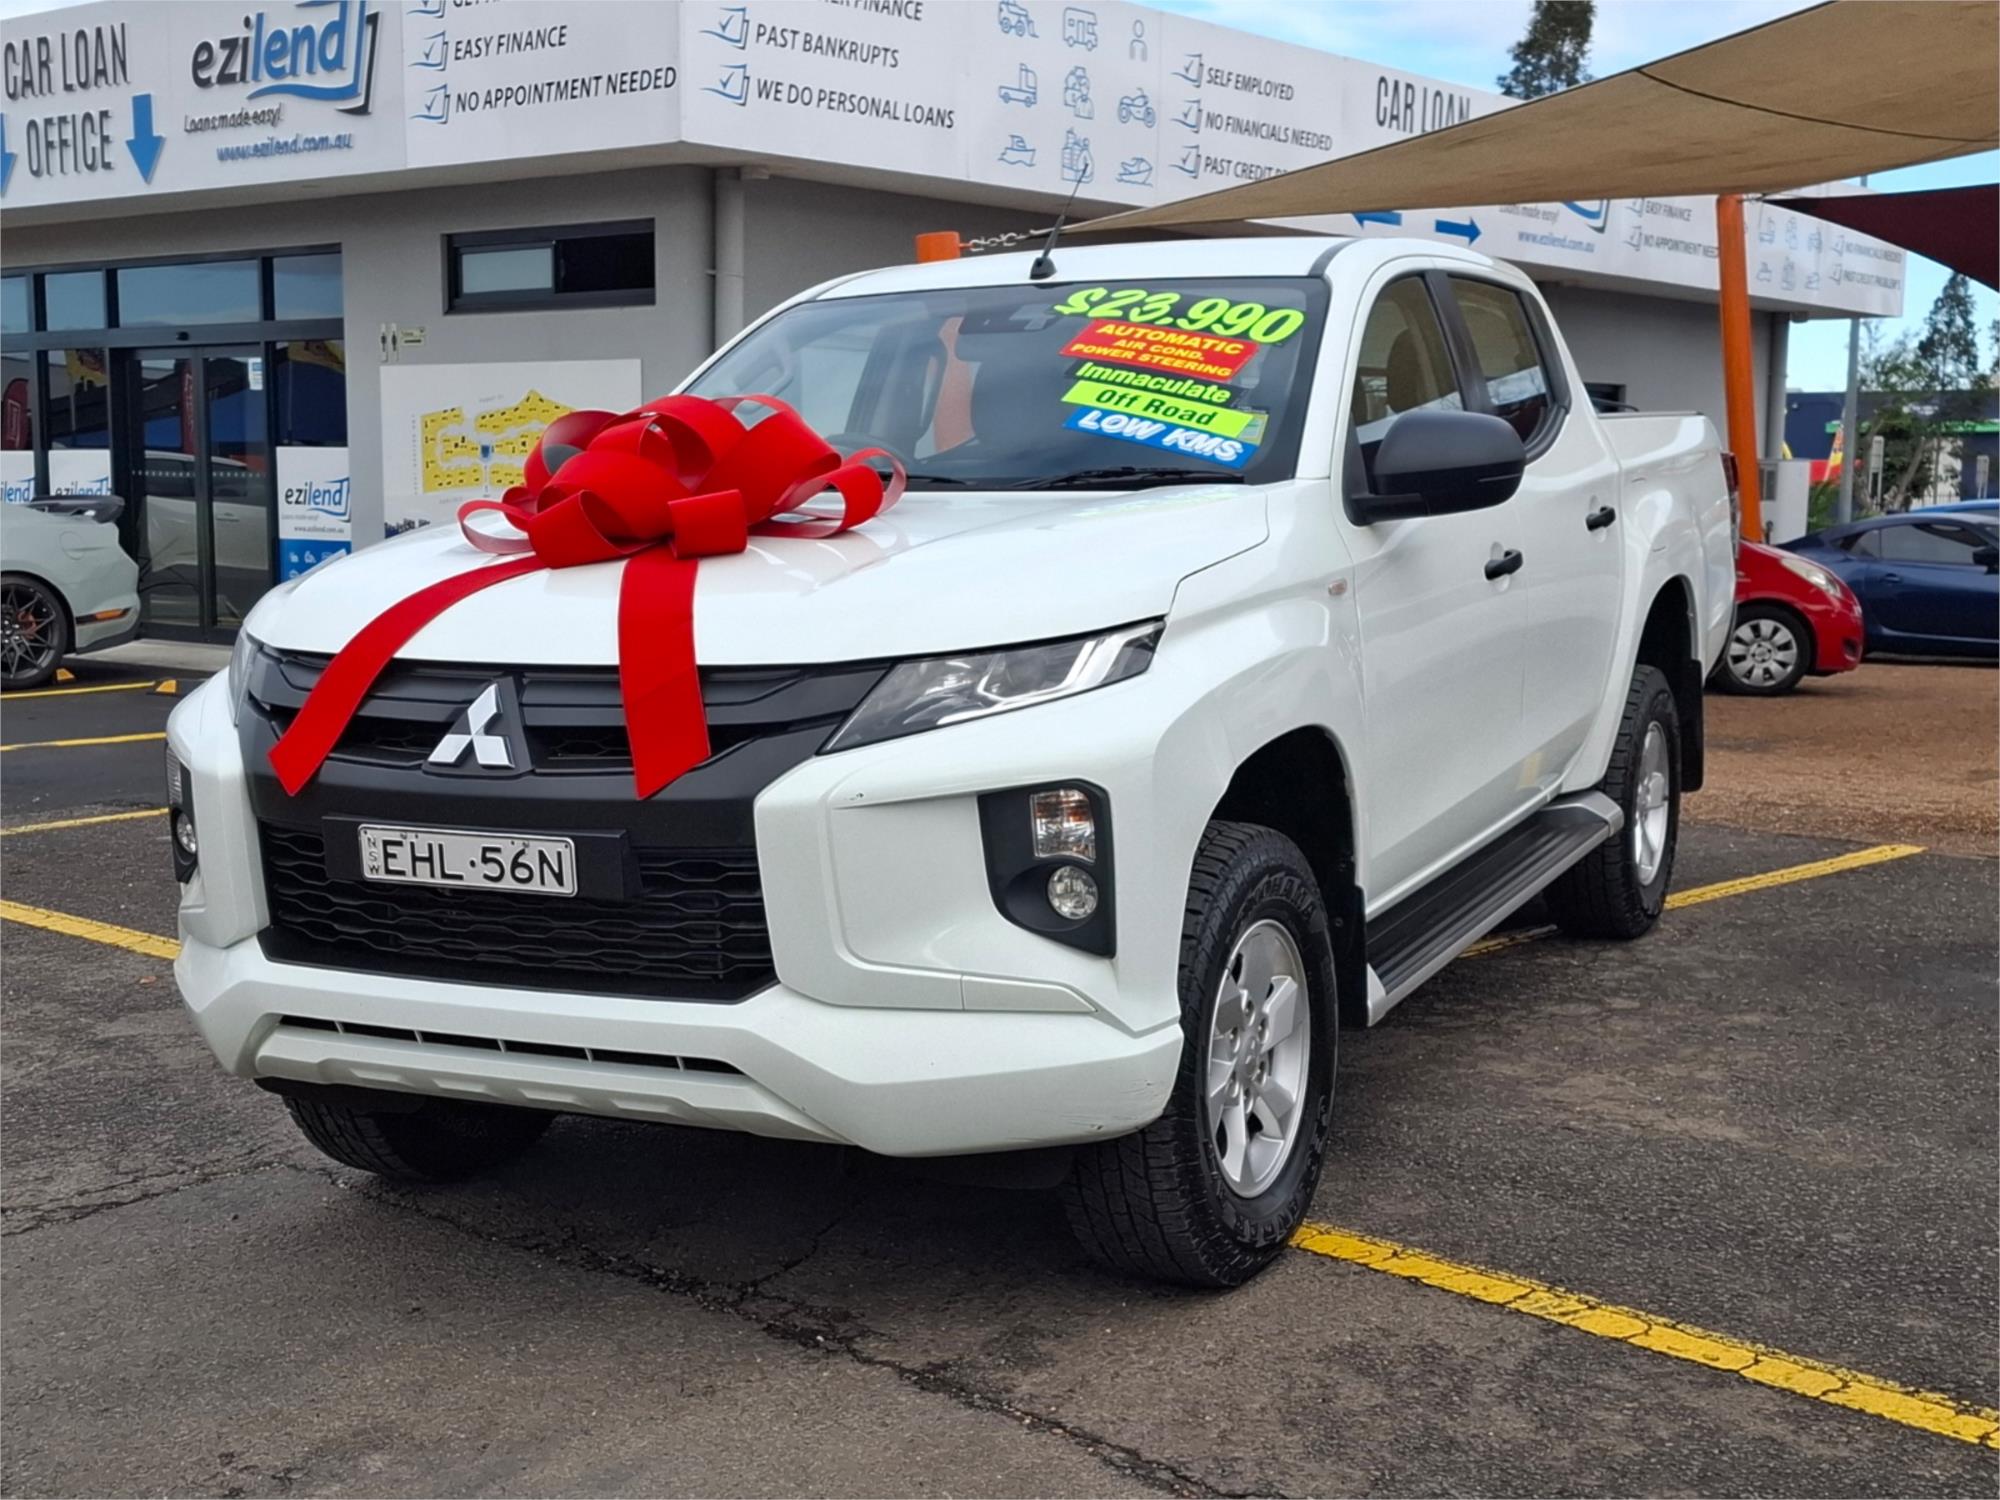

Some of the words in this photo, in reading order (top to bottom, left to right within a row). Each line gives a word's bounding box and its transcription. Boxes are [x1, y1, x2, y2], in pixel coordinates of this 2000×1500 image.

[4, 35, 54, 101] CAR
[61, 22, 130, 92] LOAN
[191, 2, 349, 88] ezilend
[454, 35, 494, 61] EASY
[496, 25, 568, 56] FINANCE
[755, 23, 800, 50] PAST
[802, 32, 899, 69] BANKRUPTS
[455, 91, 480, 114] NO
[483, 75, 602, 111] APPOINTMENT
[605, 65, 677, 96] NEEDED
[1206, 66, 1233, 88] SELF
[1235, 74, 1295, 101] EMPLOYED
[184, 114, 217, 133] Loans
[218, 107, 250, 129] made
[756, 77, 785, 101] WE
[787, 83, 813, 107] DO
[816, 88, 900, 122] PERSONAL
[904, 102, 956, 130] LOANS
[1376, 76, 1415, 134] CAR
[1421, 87, 1470, 134] LOAN
[26, 110, 114, 177] OFFICE
[216, 133, 354, 161] www.ezilend.com.au
[1205, 111, 1224, 131] NO
[1225, 114, 1290, 144] FINANCIALS
[1291, 128, 1333, 152] NEEDED
[1204, 155, 1232, 176] PAST
[1234, 161, 1274, 180] CREDIT
[1663, 204, 1692, 222] FINANCE
[1096, 324, 1245, 355] AUTOMATIC
[1115, 339, 1146, 351] AIR
[1149, 344, 1205, 361] COND.
[1071, 343, 1137, 360] POWER
[1138, 352, 1233, 377] STEERING
[1076, 362, 1232, 403] Immaculate
[1096, 389, 1138, 409] Off
[1143, 399, 1218, 426] Road
[1078, 410, 1167, 441] LOW
[1162, 427, 1245, 462] KMS
[284, 480, 343, 506] ezilend
